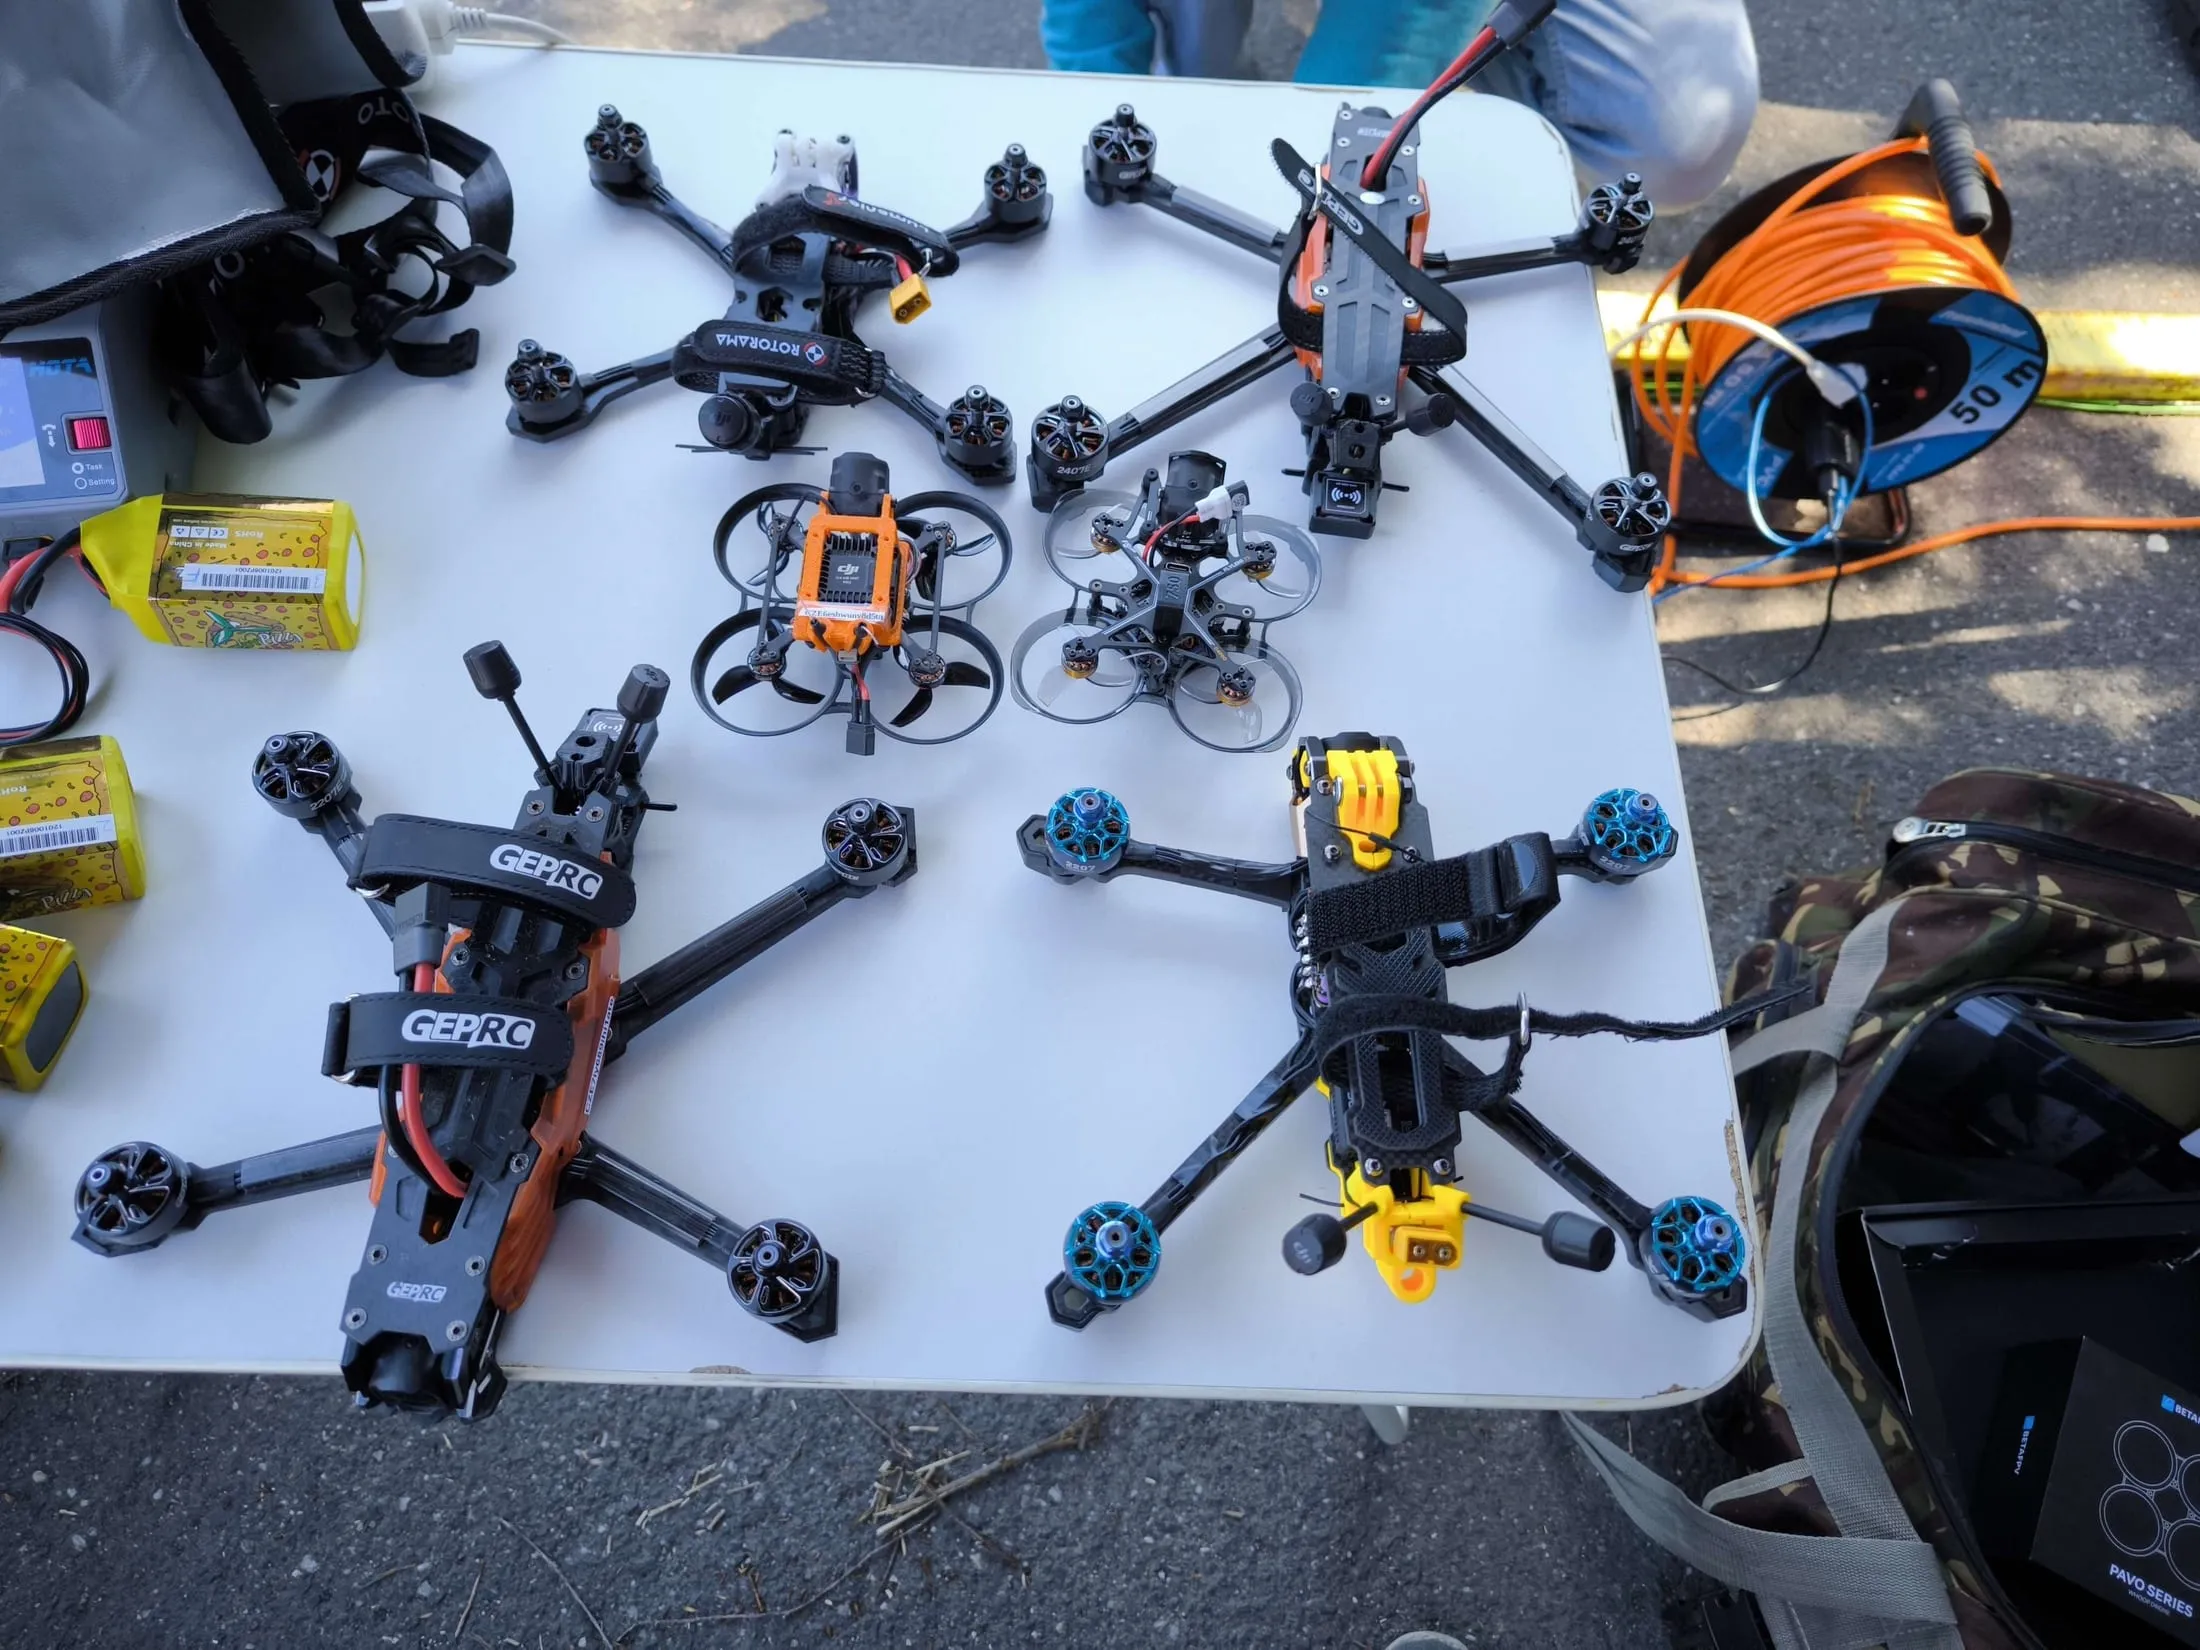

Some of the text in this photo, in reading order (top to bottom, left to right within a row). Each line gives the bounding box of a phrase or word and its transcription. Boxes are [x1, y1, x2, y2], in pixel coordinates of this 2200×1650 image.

[715, 333, 800, 357] ROTORAMA
[1948, 360, 2042, 424] 50 m
[837, 563, 860, 576] dji
[489, 843, 604, 901] GEPRC
[402, 1008, 536, 1050] GEPRC
[386, 1281, 448, 1303] GEPRC
[2013, 1430, 2030, 1476] BETAFPV
[2109, 1563, 2193, 1618] PAVO SERIES
